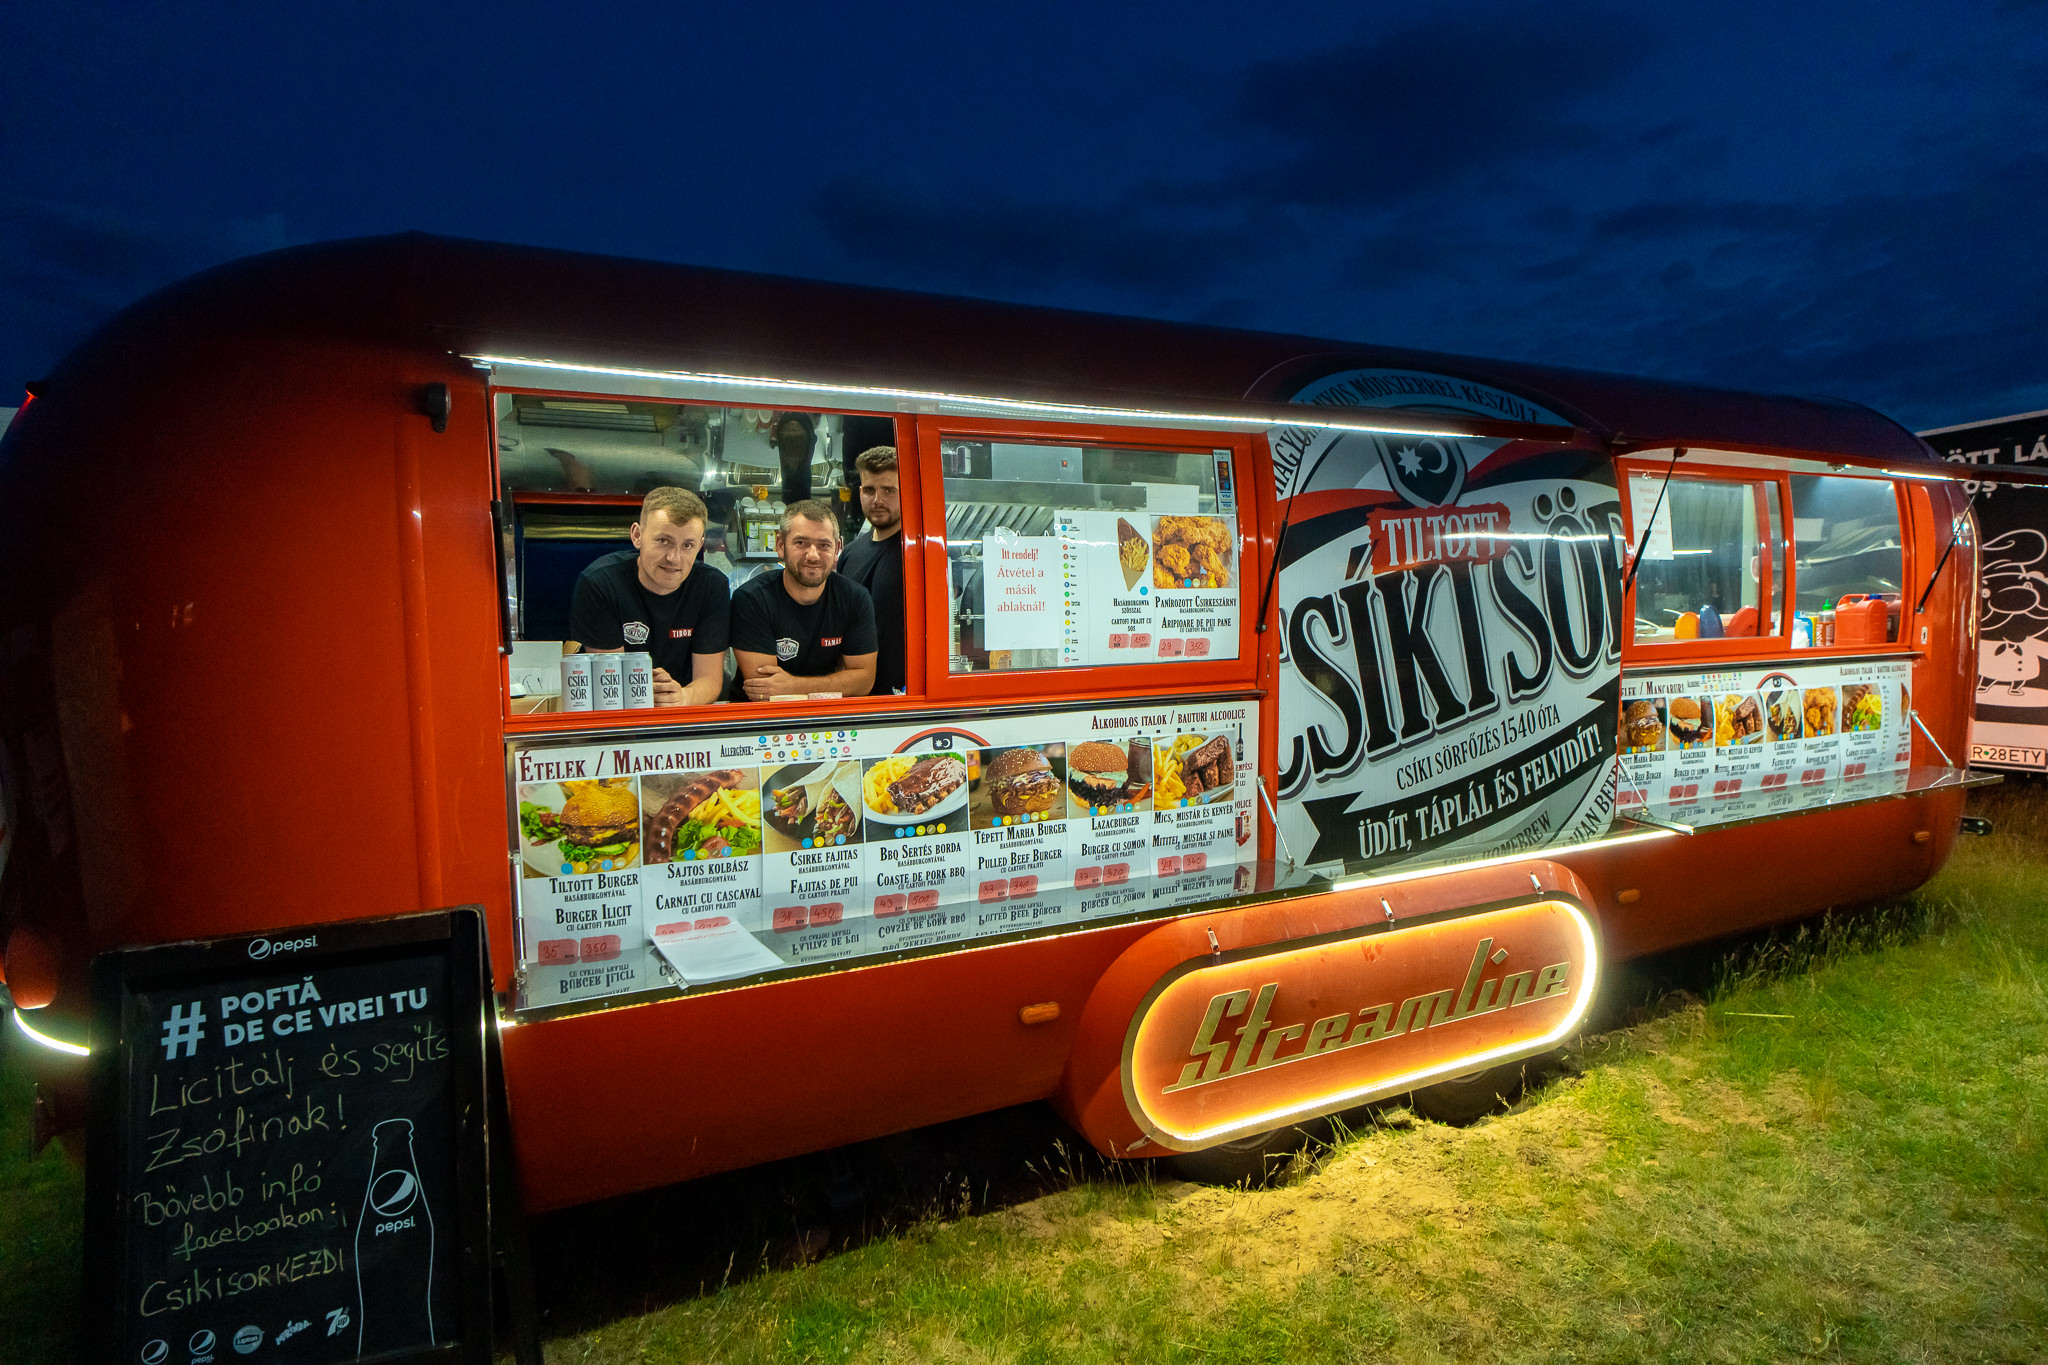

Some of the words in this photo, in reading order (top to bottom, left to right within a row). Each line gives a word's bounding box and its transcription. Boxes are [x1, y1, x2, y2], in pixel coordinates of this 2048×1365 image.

[1381, 512, 1500, 566] TILTOTT
[1002, 548, 1010, 559] Itt
[1012, 548, 1039, 561] rendelj!
[997, 565, 1034, 577] Átvétel
[1006, 584, 1036, 594] másik
[997, 601, 1045, 611] ablaknál!
[1162, 617, 1194, 628] ARIPIOARE
[1197, 619, 1204, 627] DE
[1206, 619, 1215, 627] PUI
[1217, 618, 1231, 626] PANE
[672, 630, 692, 638] TIBOR
[568, 674, 588, 687] CSÍKI
[600, 673, 620, 686] CSÍKI
[629, 672, 648, 685] CSÍKI
[571, 687, 587, 700] SÖR
[603, 686, 619, 699] SÖR
[632, 685, 647, 697] SÖR
[1091, 715, 1138, 730] ALKOHOLOS
[1141, 713, 1167, 727] ITALOK
[1178, 711, 1208, 724] BAUTURI
[1210, 709, 1246, 721] ALCOOLICE
[1396, 757, 1434, 790] CSÍKI
[1436, 725, 1500, 775] SÖRFŐZÉS
[1501, 709, 1536, 746] 1540
[1537, 703, 1561, 730] ÓTA
[519, 750, 586, 782] ÉTELEK
[612, 750, 712, 775] MANCARURI
[1358, 810, 1412, 860] ÜDÍT,
[1416, 781, 1493, 841] TÁPLÁL
[1494, 769, 1519, 810] ÉS
[1520, 723, 1603, 796] FELVIDÍT!
[1154, 812, 1173, 824] MICS,
[1176, 809, 1200, 821] MUSTÁR
[1203, 807, 1209, 817] ÉS
[1212, 804, 1233, 816] KENYÉR
[1092, 816, 1139, 831] LAZACBURGER
[974, 831, 1003, 844] TÉPETT
[1007, 827, 1034, 840] MARHA
[1038, 823, 1067, 836] BURGER
[1183, 832, 1207, 843] MUSTAR
[1209, 831, 1215, 840] SI
[1218, 828, 1233, 839] PAINE
[880, 847, 898, 861] BBQ
[902, 844, 932, 858] SERTÉS
[936, 842, 961, 853] BORDA
[1082, 844, 1109, 856] BURGER
[1112, 842, 1120, 852] CU
[1123, 839, 1146, 850] SOMON
[790, 852, 822, 866] CSIRKE
[826, 849, 858, 862] FAJITAS
[978, 857, 1007, 870] PULLED
[1011, 852, 1030, 865] BEEF
[1033, 849, 1062, 861] BURGER
[668, 864, 704, 879] SAJTOS
[709, 860, 748, 874] KOLBÁSZ
[877, 873, 909, 887] COASTE
[912, 872, 922, 882] DE
[926, 869, 946, 880] PORK
[950, 866, 965, 877] BBQ
[549, 877, 593, 894] TILTOTT
[598, 873, 638, 889] BURGER
[790, 880, 826, 894] FAJITAS
[830, 878, 840, 888] DE
[845, 877, 858, 887] PUI
[984, 884, 994, 895] 33
[656, 894, 697, 910] CARNATI
[701, 893, 712, 903] CU
[716, 888, 761, 901] CASCAVAL
[808, 891, 829, 899] CARTOFI
[556, 908, 598, 924] BURGER
[602, 904, 632, 920] ILICIT
[691, 904, 713, 913] CARTOFI
[577, 922, 601, 930] CARTOFI
[272, 935, 317, 955] pepsi
[220, 976, 321, 1019] POFTĂ
[223, 1020, 264, 1047] DE
[272, 1008, 313, 1037] CE
[318, 995, 384, 1028] VREI
[391, 987, 428, 1014] TU
[1161, 937, 1571, 1094] Streamline
[149, 1048, 294, 1117] Licitálj
[318, 1042, 361, 1078] és
[261, 1161, 322, 1205] infó
[375, 1216, 416, 1236] pepsi
[236, 1335, 258, 1345] Lipton
